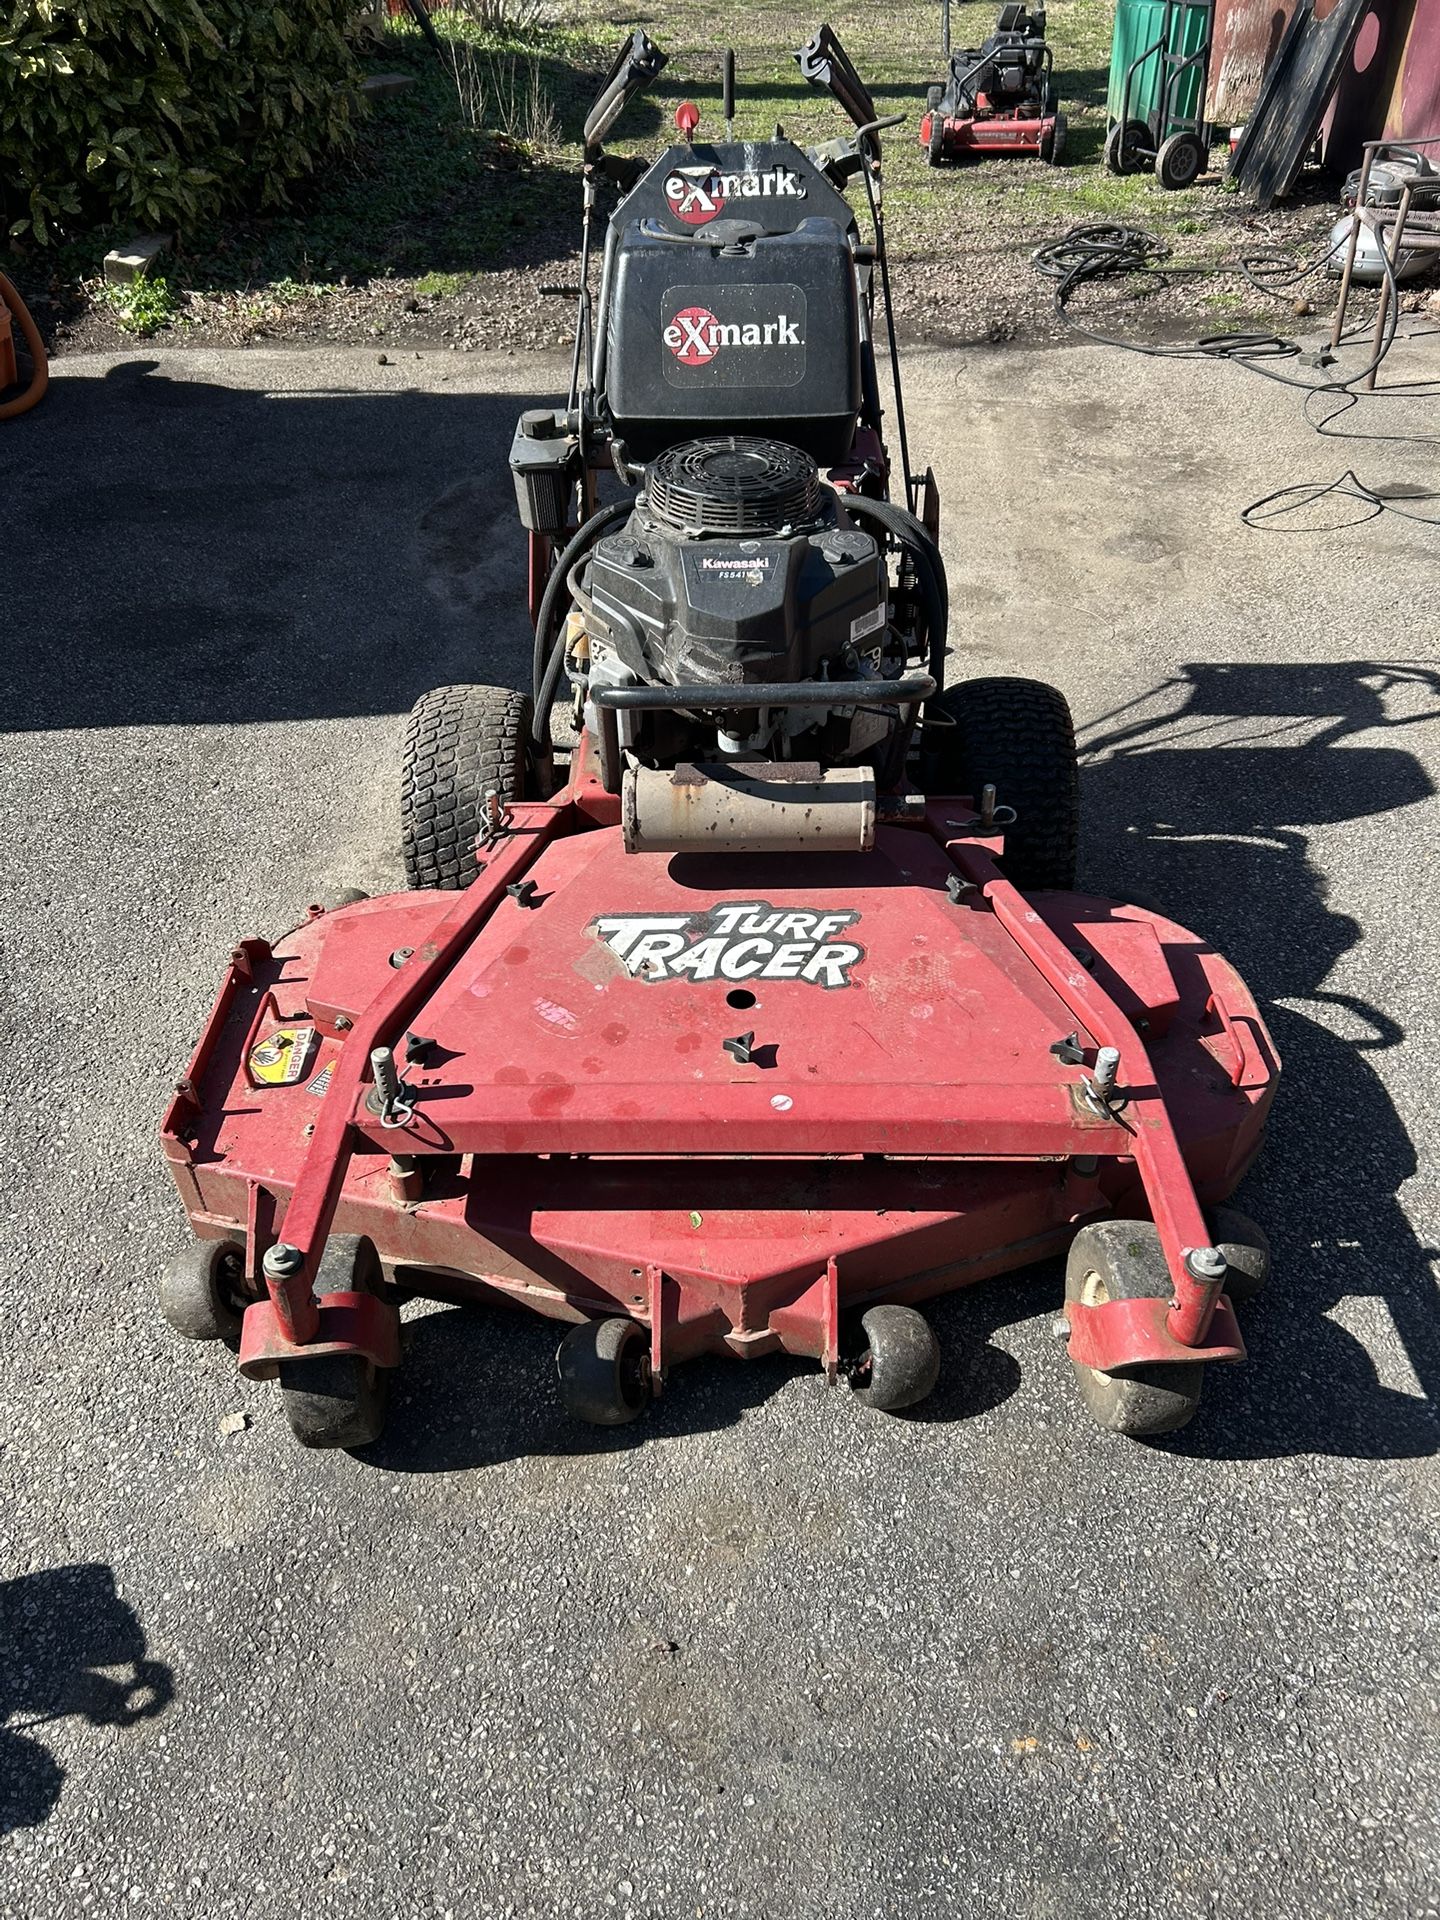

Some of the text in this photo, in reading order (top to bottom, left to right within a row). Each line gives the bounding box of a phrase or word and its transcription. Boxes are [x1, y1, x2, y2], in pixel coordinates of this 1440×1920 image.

[702, 557, 769, 569] Kawasaki
[715, 905, 853, 940] TURF
[597, 917, 860, 987] TRACER
[287, 1033, 307, 1078] DANGER
